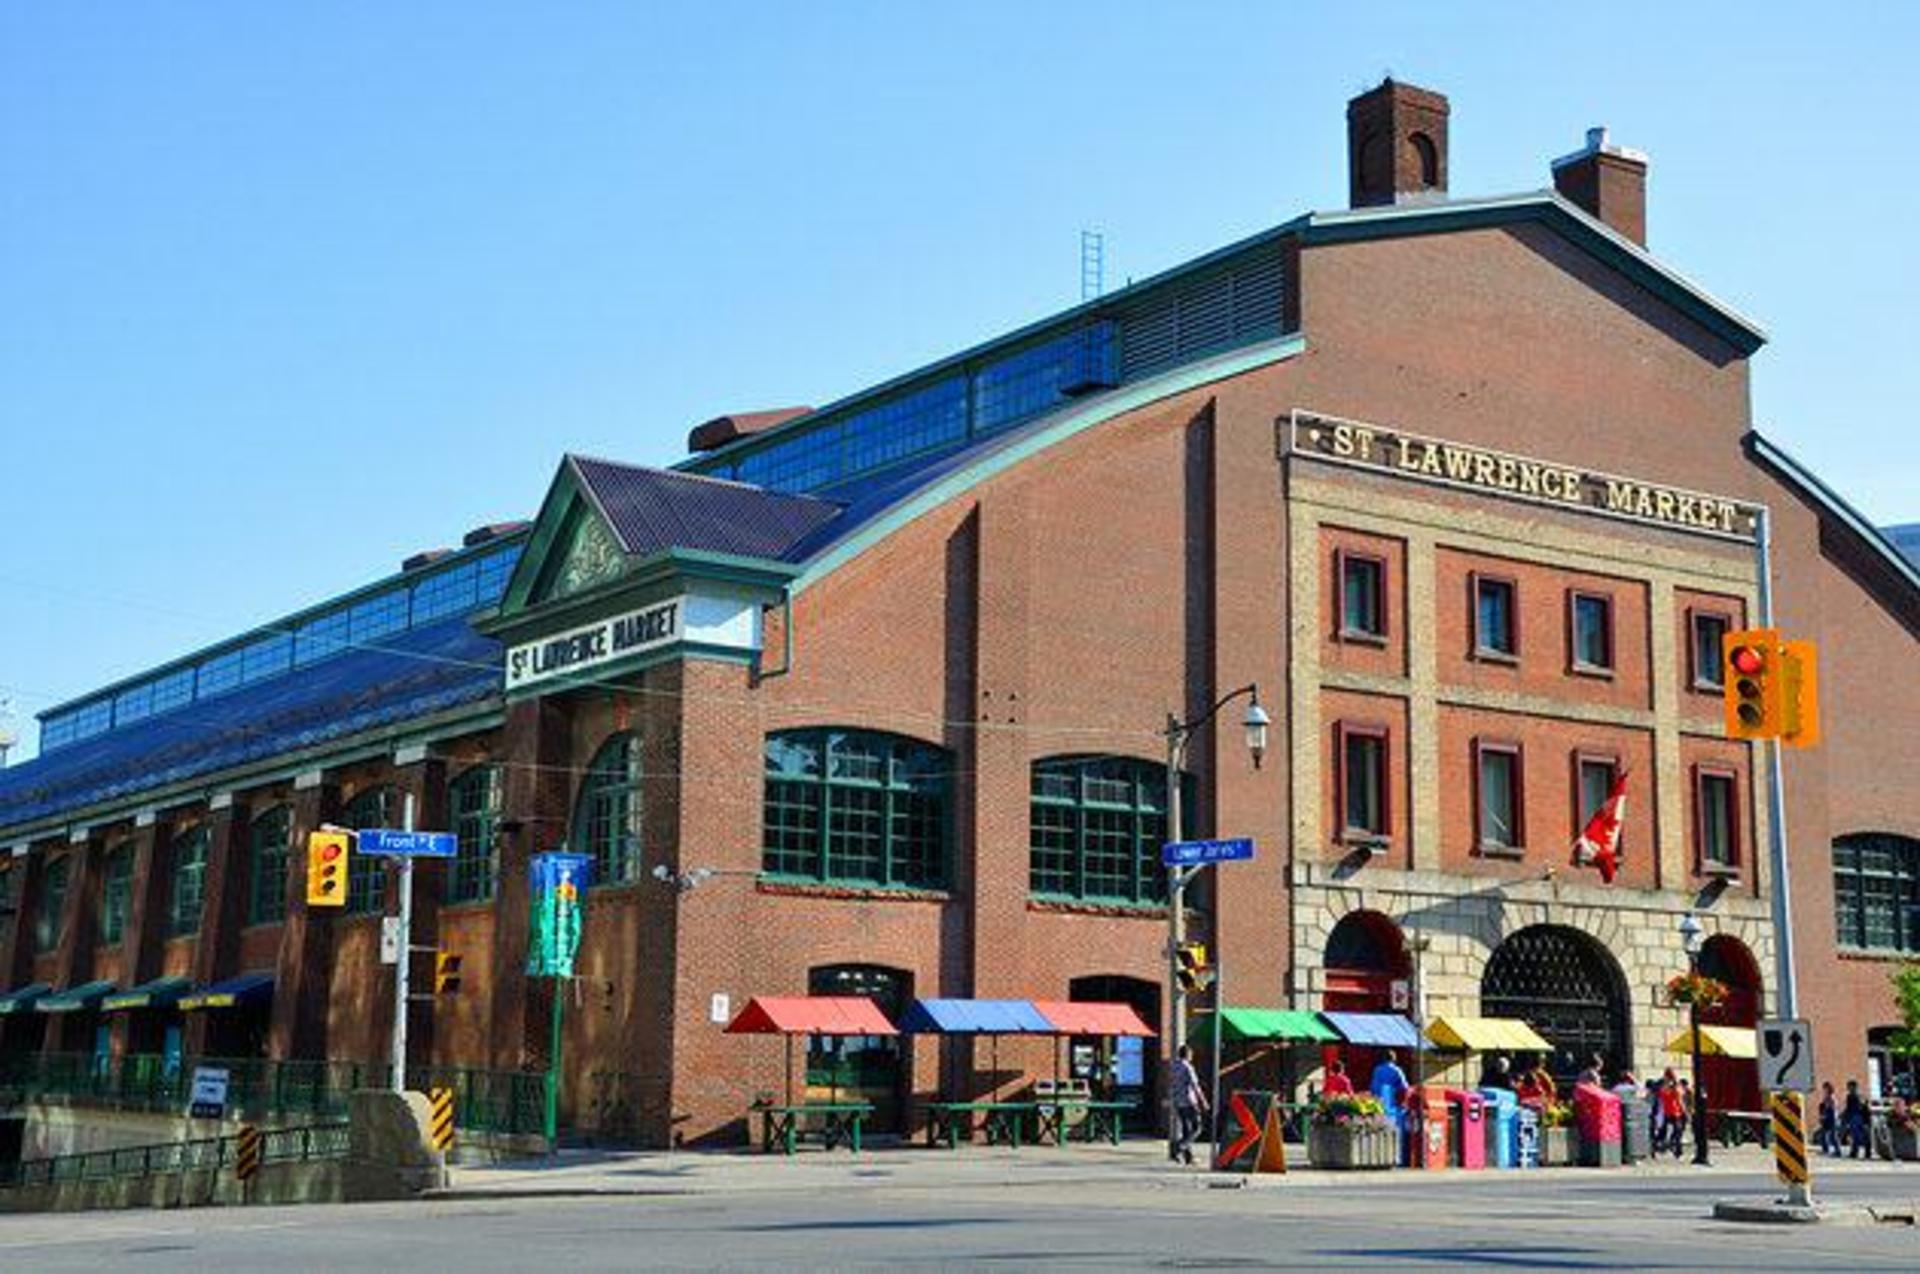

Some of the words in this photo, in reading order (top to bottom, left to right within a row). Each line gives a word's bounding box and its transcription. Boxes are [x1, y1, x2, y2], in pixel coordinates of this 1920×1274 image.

[1334, 425, 1374, 458] ST
[1398, 438, 1581, 501] LAWRENCE
[1606, 481, 1736, 531] MARKET
[612, 603, 677, 652] MARKET
[379, 833, 416, 849] Front
